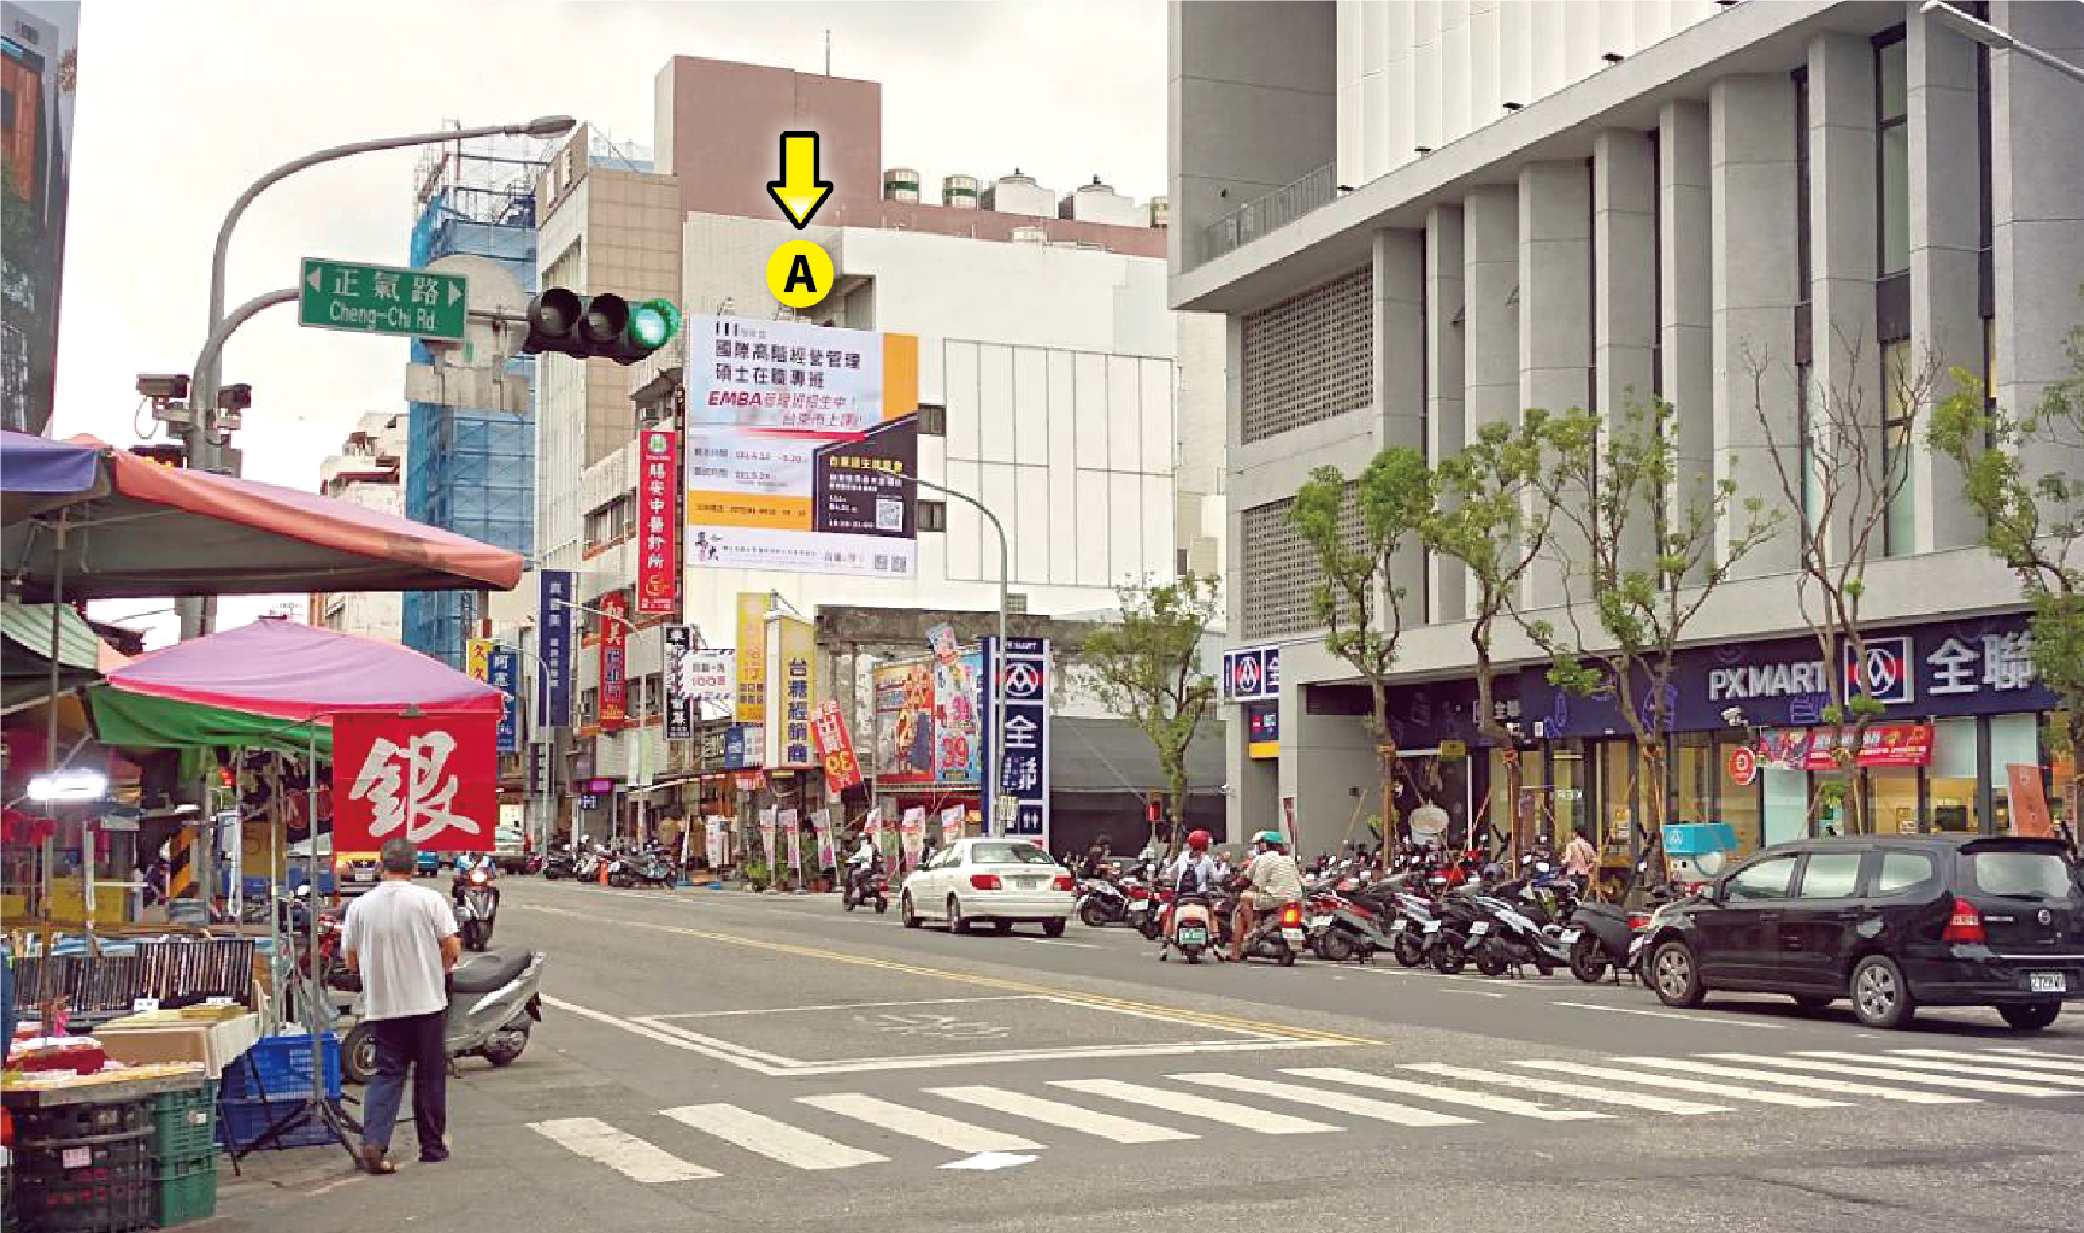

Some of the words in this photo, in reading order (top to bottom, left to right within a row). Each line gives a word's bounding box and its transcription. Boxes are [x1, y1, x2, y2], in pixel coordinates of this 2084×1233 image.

[332, 267, 440, 307] 正氣路
[1925, 631, 2038, 696] 全聯
[347, 730, 481, 844] 銀
[1001, 714, 1038, 791] 全聯
